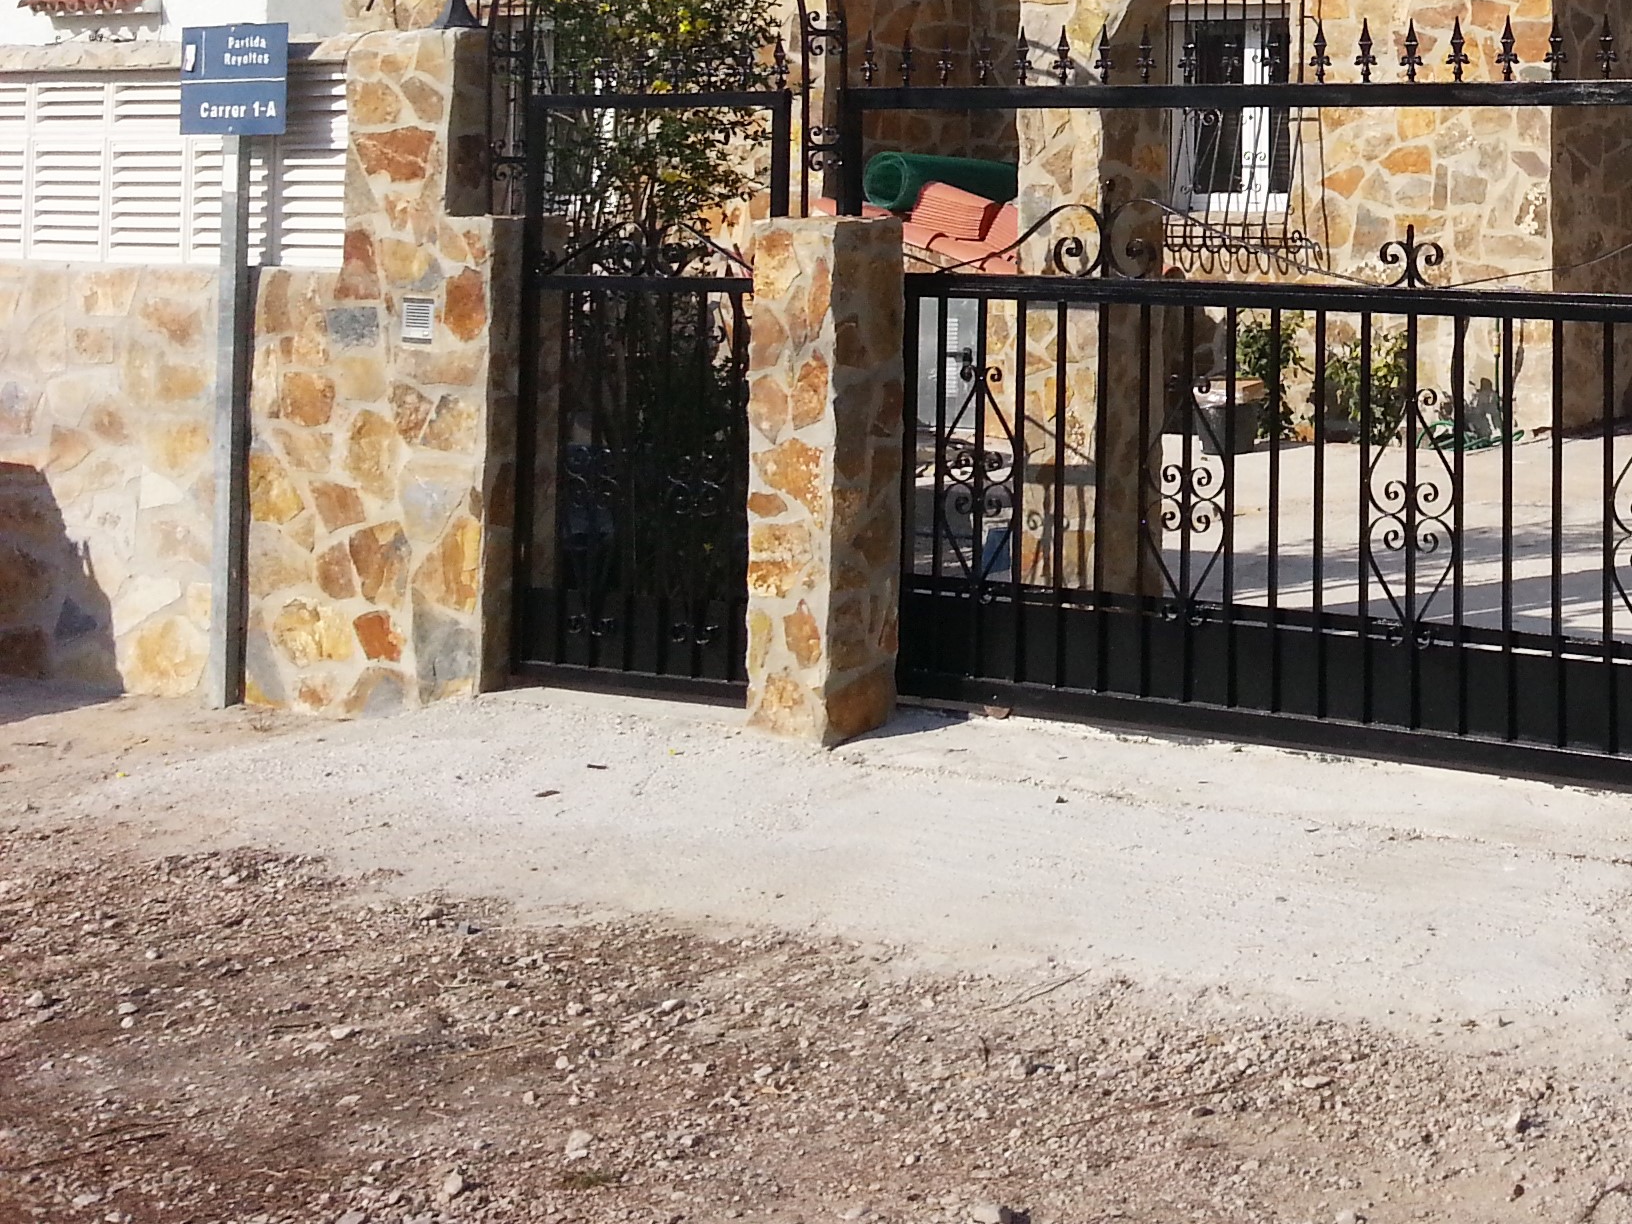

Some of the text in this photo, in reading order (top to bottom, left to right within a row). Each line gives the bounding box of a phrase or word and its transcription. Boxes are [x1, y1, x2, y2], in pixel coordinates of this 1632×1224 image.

[227, 36, 267, 49] Partida
[200, 100, 277, 118] Carrer 1-A
